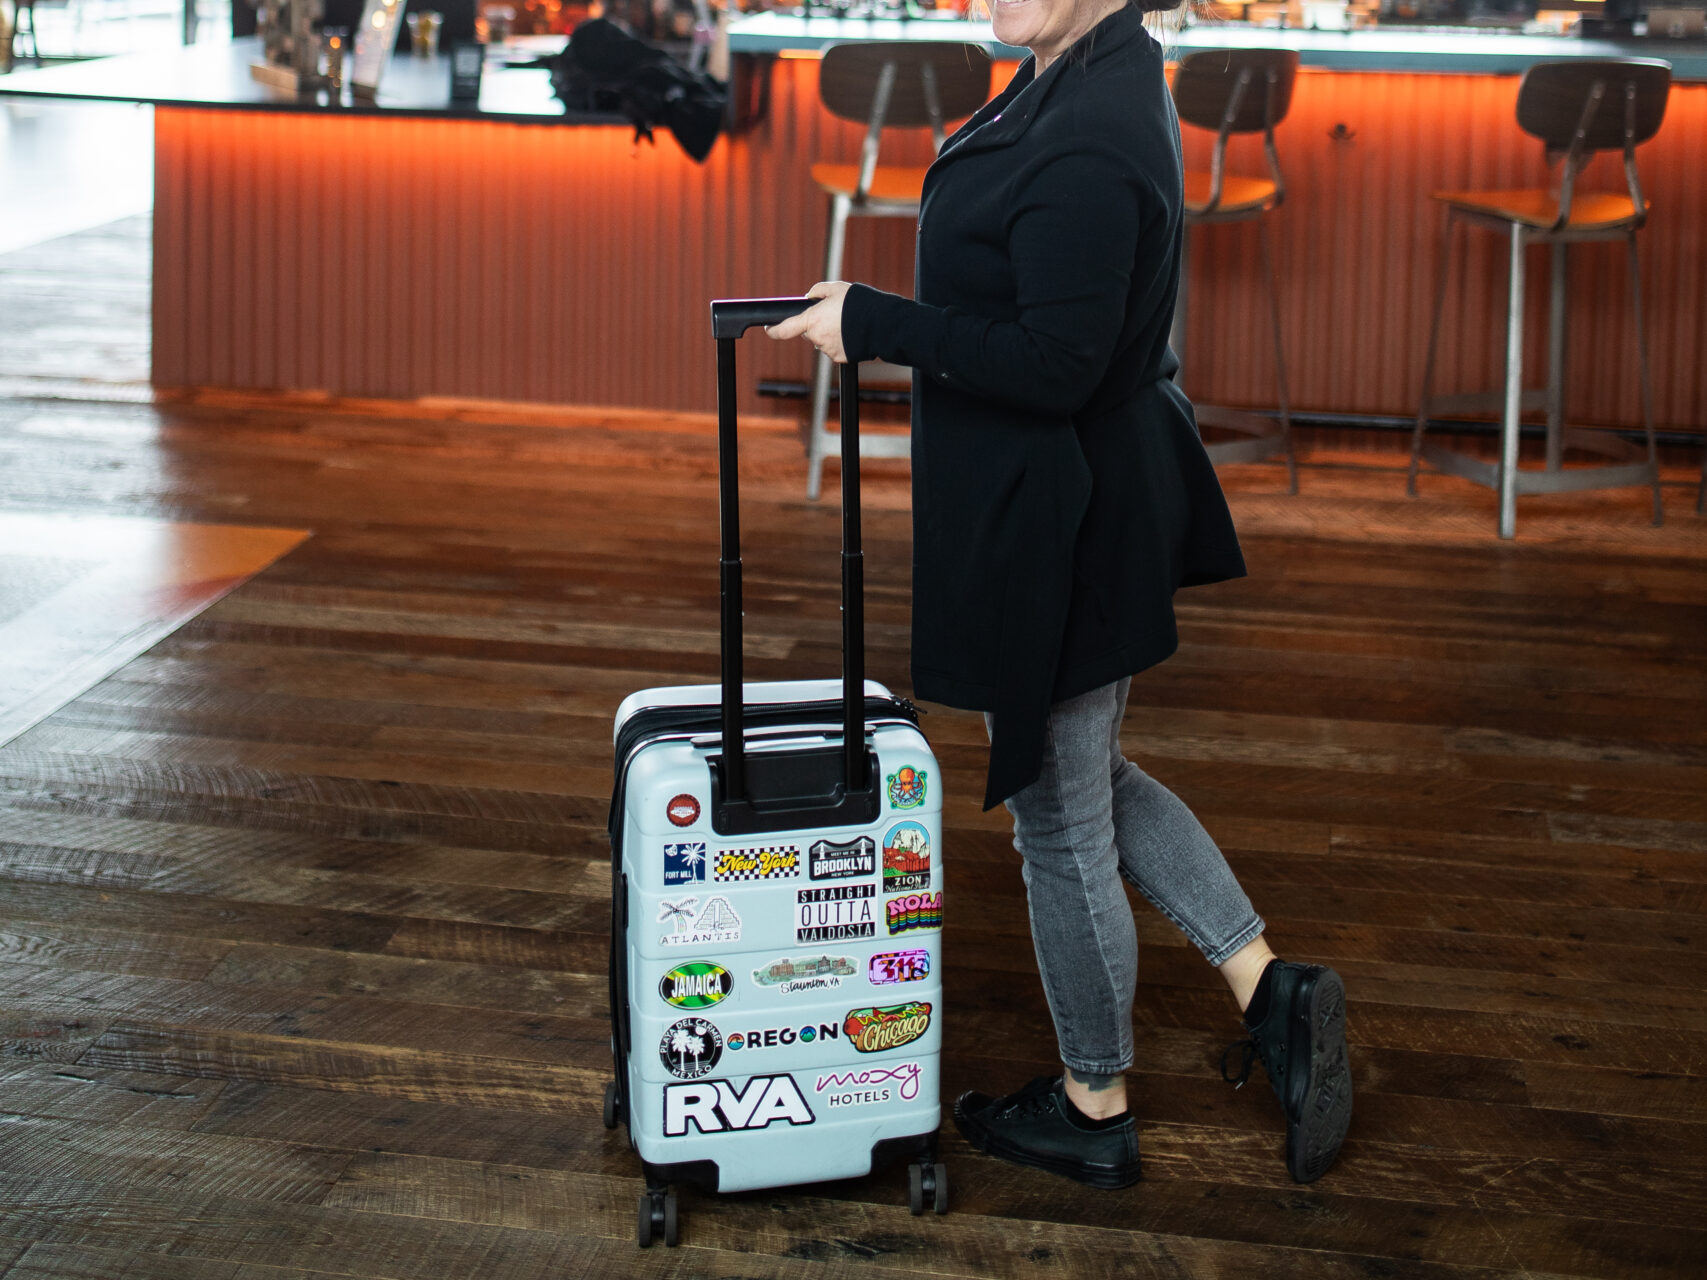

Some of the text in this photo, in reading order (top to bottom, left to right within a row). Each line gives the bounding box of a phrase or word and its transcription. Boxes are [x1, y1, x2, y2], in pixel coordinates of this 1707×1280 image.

[717, 852, 796, 875] New York
[814, 856, 872, 876] BROOKLYN
[665, 870, 692, 879] FORT MILL
[895, 875, 922, 886] ZION
[801, 885, 872, 902] STRAIGHT
[801, 900, 871, 926] OUTTA
[887, 892, 942, 919] NOLA
[661, 932, 739, 944] ATLANTIS
[801, 924, 872, 942] VALDOSTA
[671, 973, 722, 998] JAMAICA
[829, 977, 840, 987] VA
[660, 1018, 723, 1054] PLAYA DEL CARMEN
[727, 1022, 839, 1051] OREGON
[864, 1014, 929, 1051] Chicago
[672, 1065, 712, 1079] MEXICO
[816, 1063, 922, 1100] moxy
[663, 1073, 816, 1137] RVA
[830, 1090, 890, 1106] HOTELS
